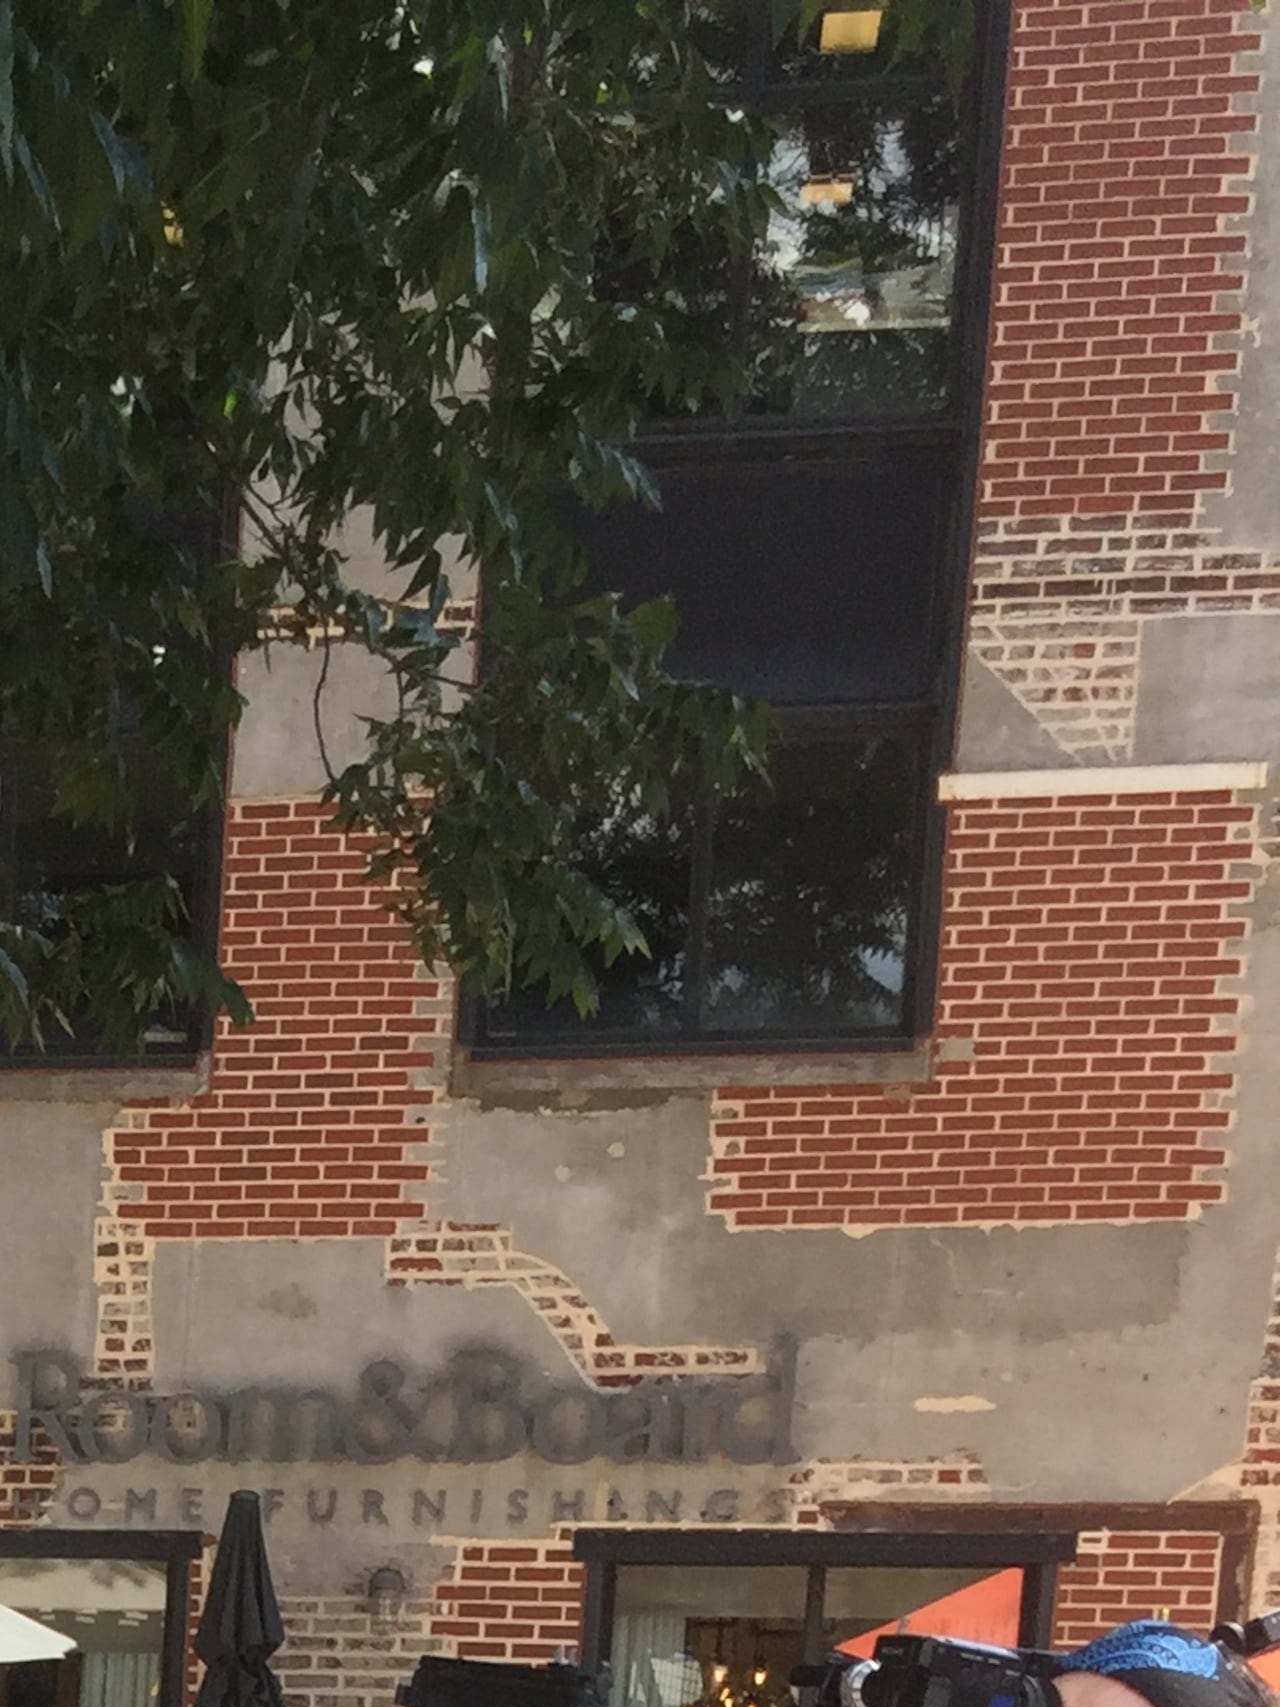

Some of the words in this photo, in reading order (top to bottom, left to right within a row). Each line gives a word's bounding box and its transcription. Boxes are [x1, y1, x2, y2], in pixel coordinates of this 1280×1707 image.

[9, 1334, 804, 1465] Room&Board
[13, 1486, 205, 1523] HOME
[261, 1487, 794, 1525] FURNISHINGS
